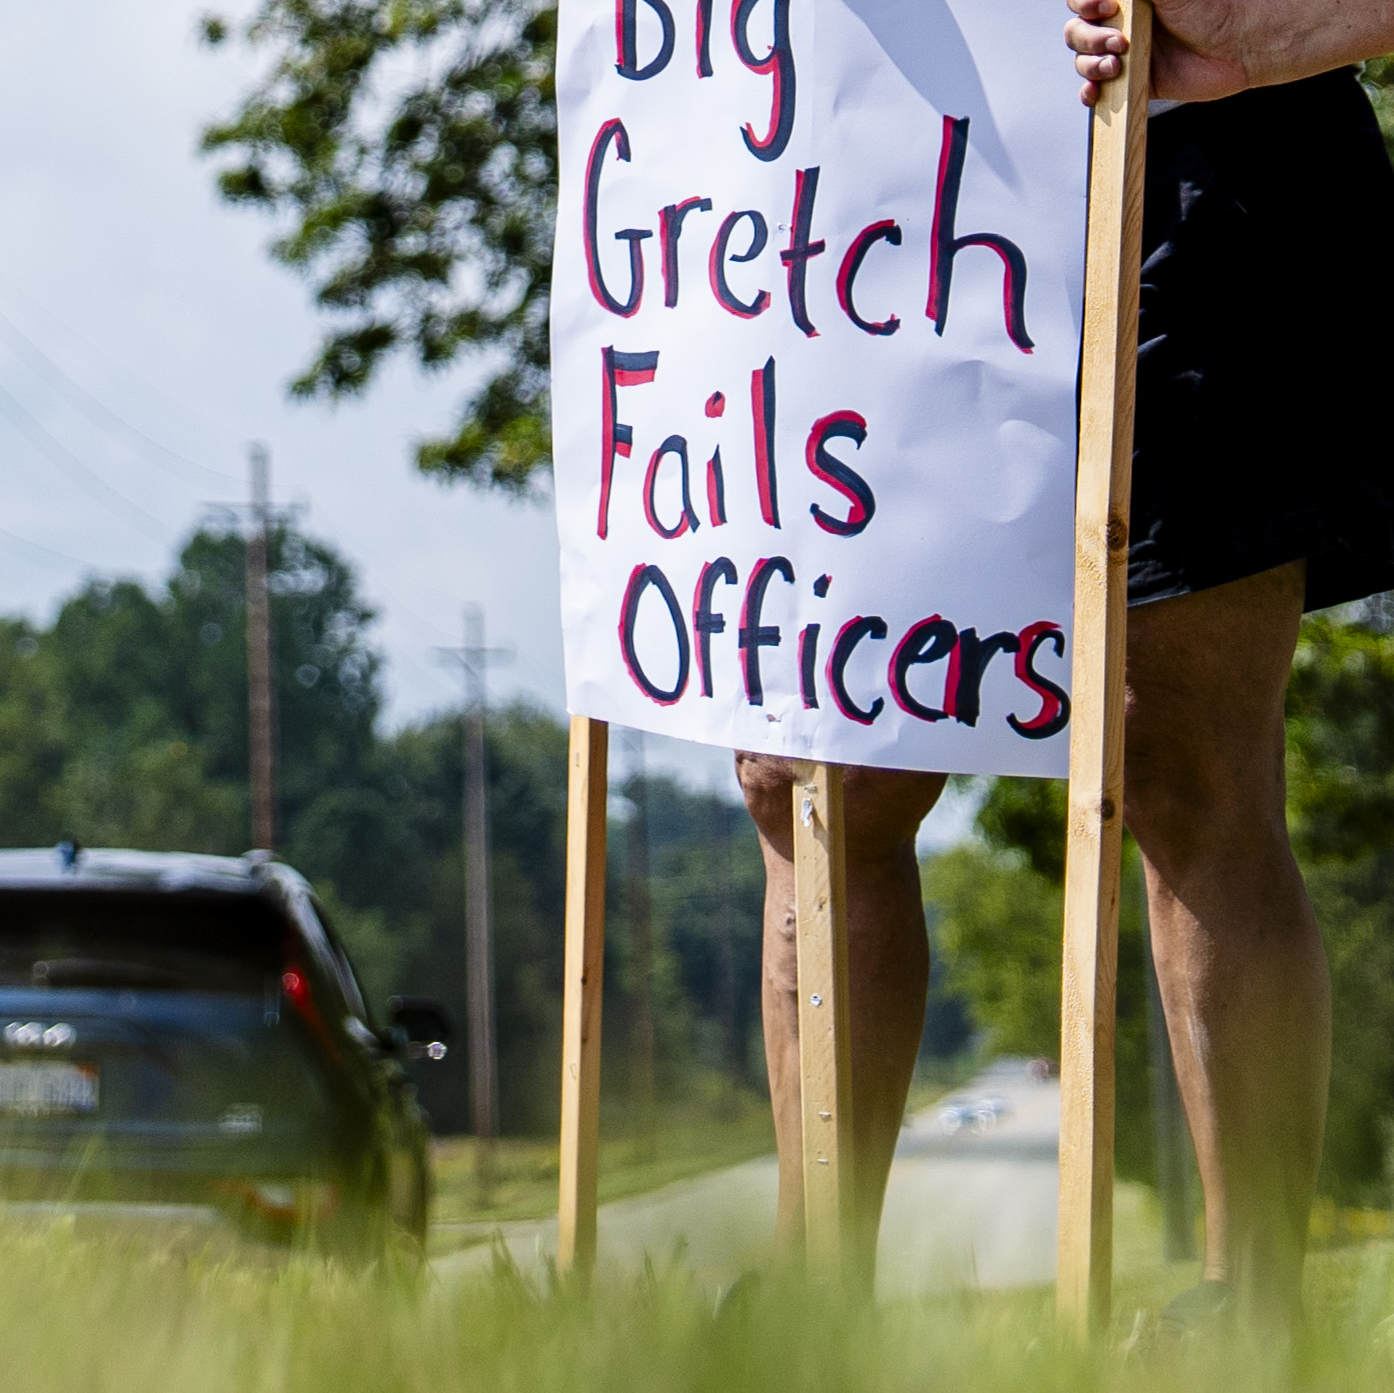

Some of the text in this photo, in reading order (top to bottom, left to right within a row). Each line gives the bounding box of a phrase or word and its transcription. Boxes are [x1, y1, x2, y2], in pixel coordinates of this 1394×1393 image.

[583, 115, 1035, 354] Gretch
[597, 344, 877, 539] Fails
[618, 555, 1071, 740] Officers
